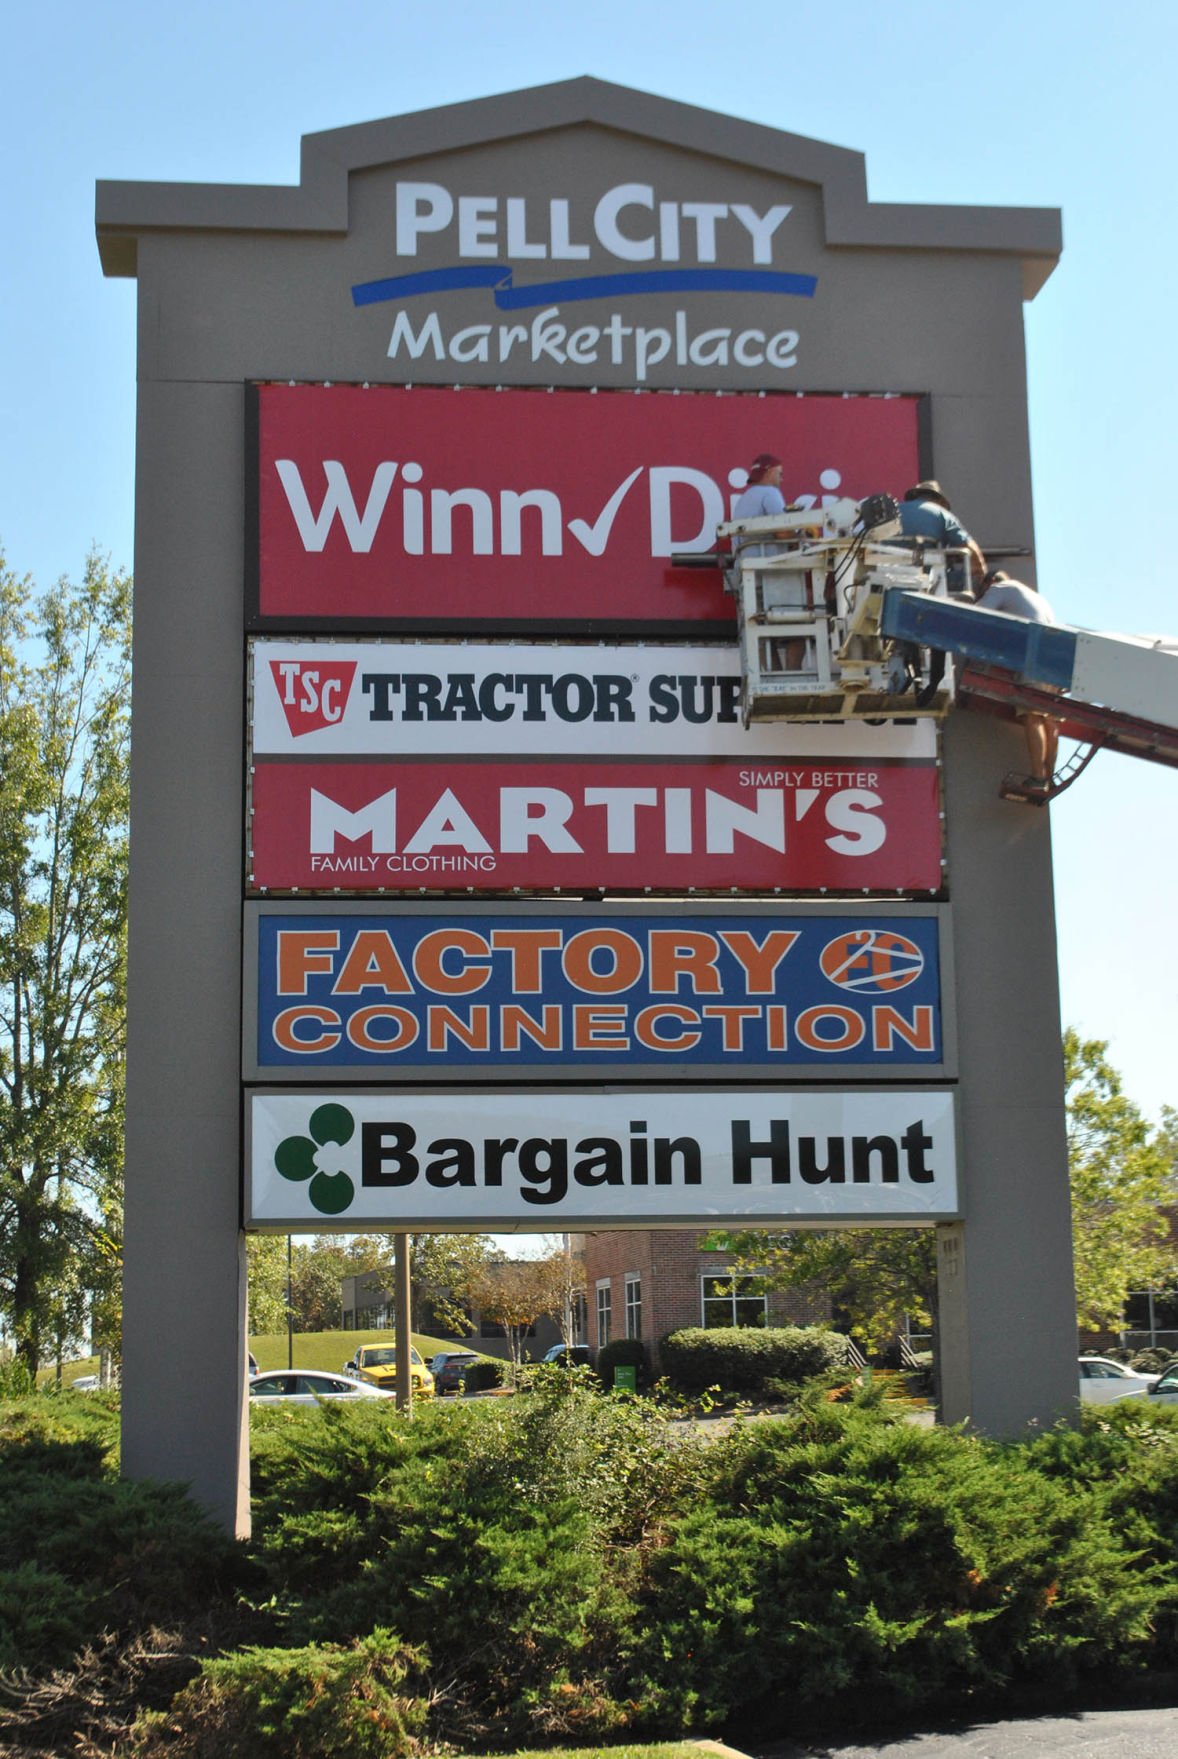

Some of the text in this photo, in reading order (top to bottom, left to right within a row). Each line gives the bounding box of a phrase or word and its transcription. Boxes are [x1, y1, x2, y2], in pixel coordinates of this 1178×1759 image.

[387, 306, 800, 381] Marketplace
[275, 459, 563, 556] Winn
[280, 663, 341, 722] TSC
[739, 771, 879, 788] SIMPLY BETTER
[310, 787, 887, 856] MARTIN'S
[311, 855, 497, 872] FAMILY CLOTHING
[276, 927, 801, 996] FACTORY
[272, 1003, 935, 1053] CONNECTION
[361, 1119, 936, 1205] Bargain Hunt
